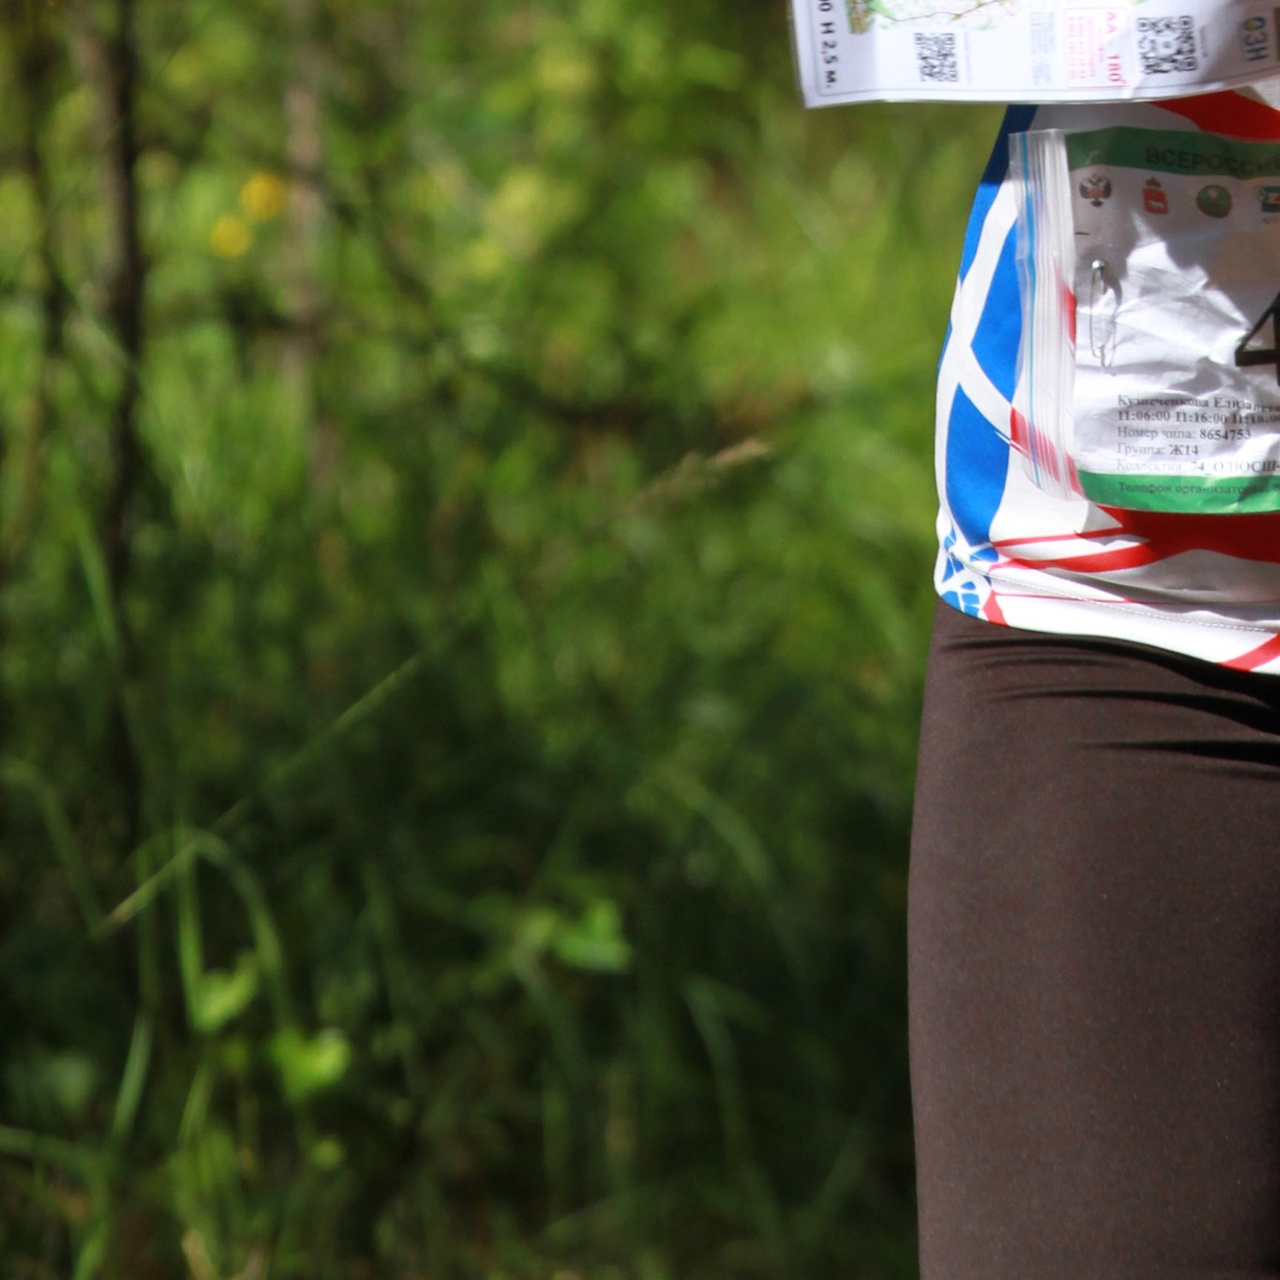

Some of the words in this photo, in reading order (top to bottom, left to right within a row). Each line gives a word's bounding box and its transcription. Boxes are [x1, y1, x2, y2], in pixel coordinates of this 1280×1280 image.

[820, 40, 838, 65] 2,5
[1117, 410, 1171, 422] 11:06:00
[1175, 411, 1227, 424] 11:16:00
[1117, 426, 1158, 441] Номер
[1168, 443, 1199, 456] Ж14
